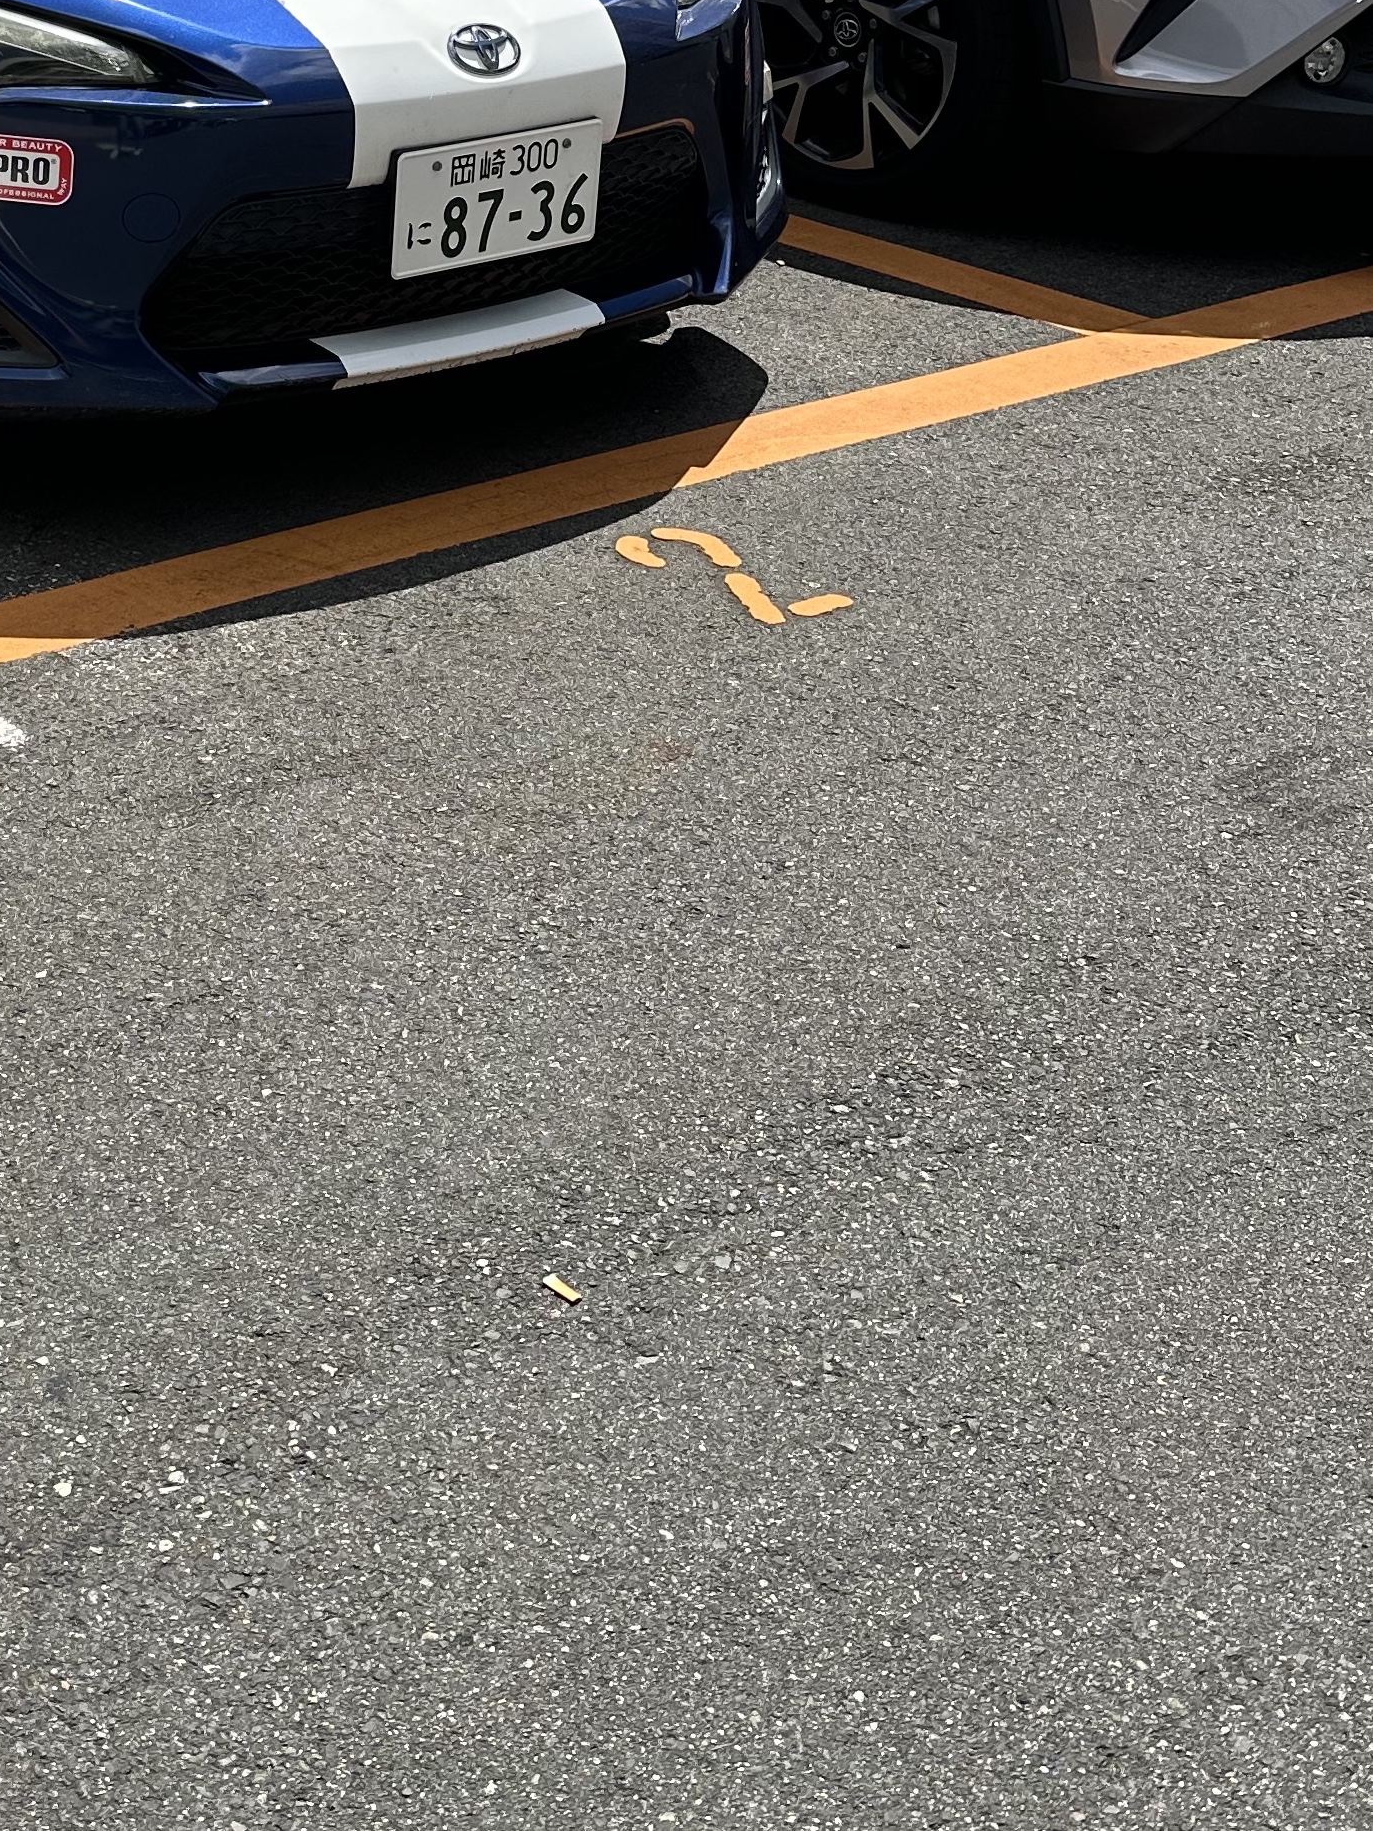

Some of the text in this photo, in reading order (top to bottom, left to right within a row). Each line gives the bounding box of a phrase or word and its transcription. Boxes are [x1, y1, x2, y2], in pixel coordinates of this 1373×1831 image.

[11, 139, 62, 152] BEAUTY
[450, 138, 559, 187] 岡崎 300
[407, 172, 589, 259] に 87-36
